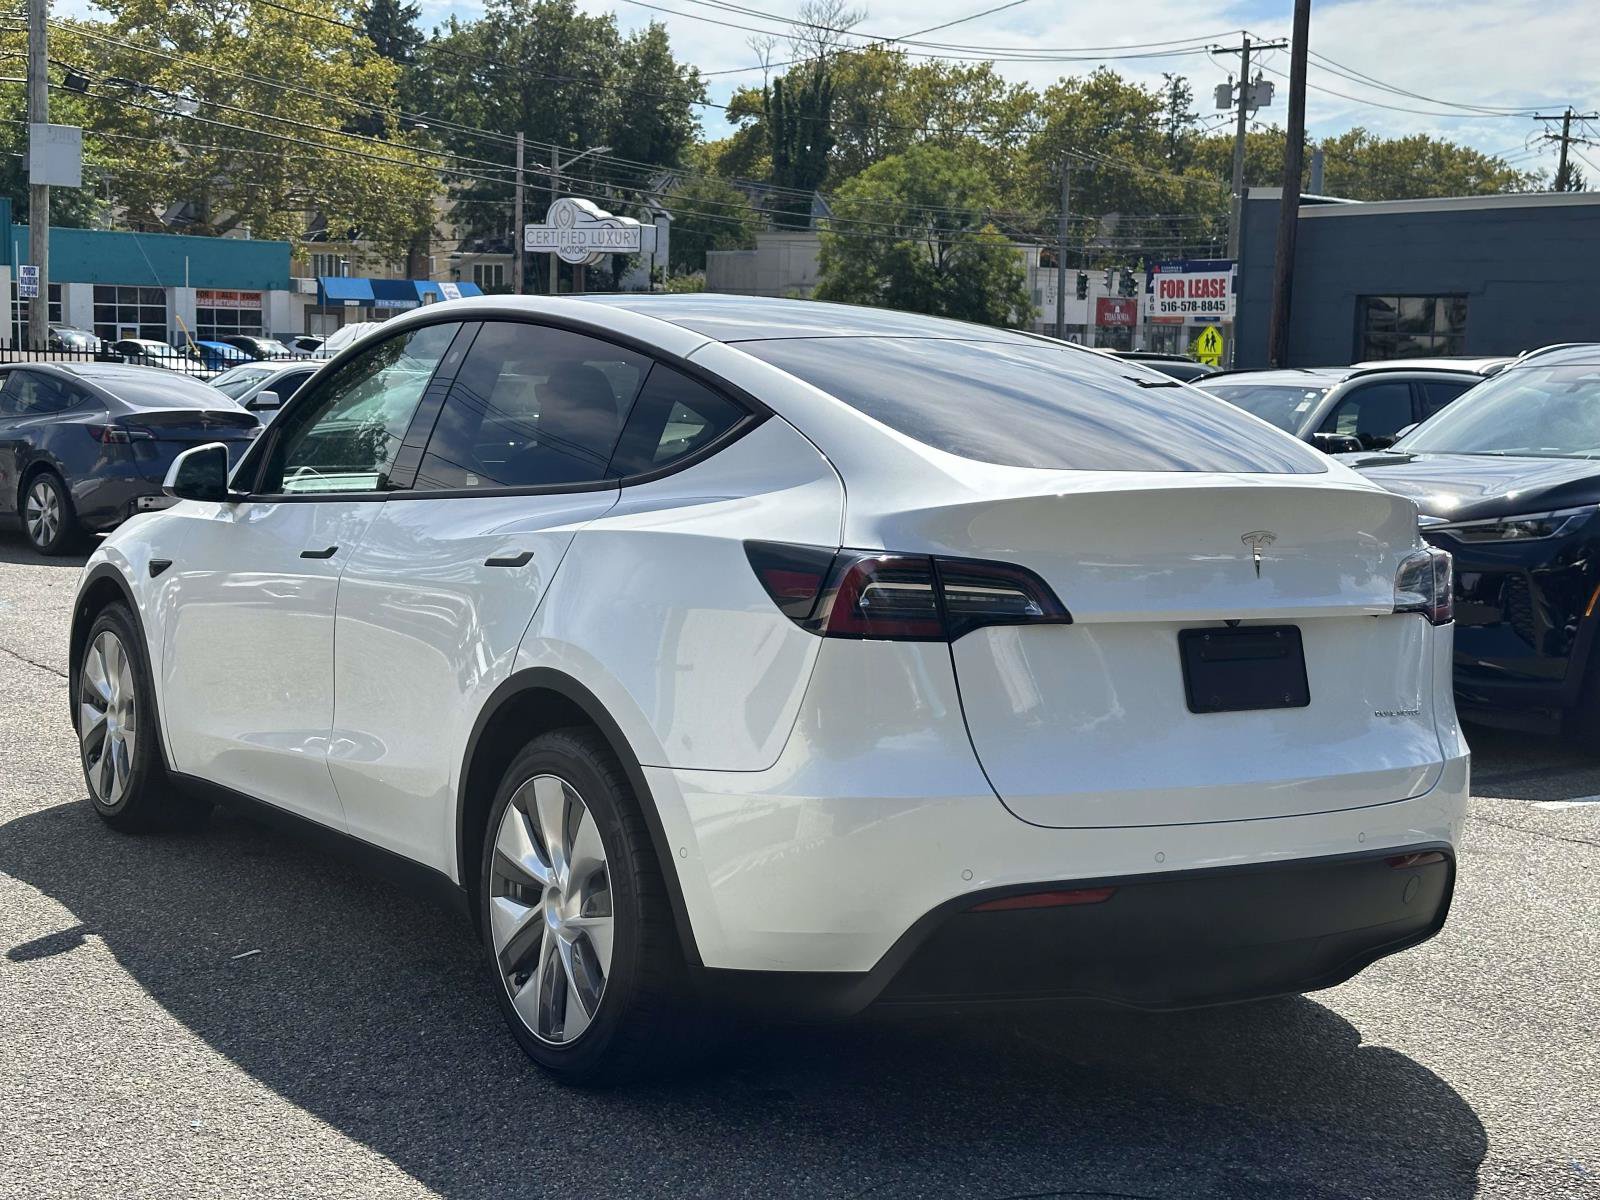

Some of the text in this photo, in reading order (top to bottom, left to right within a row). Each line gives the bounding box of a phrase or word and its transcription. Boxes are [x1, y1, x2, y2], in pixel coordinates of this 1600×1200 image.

[526, 231, 638, 245] CERTIFIED LUXURY
[560, 246, 587, 254] MOTORS
[1160, 278, 1226, 299] FOR LEASE
[1160, 301, 1226, 312] 516-578-8845
